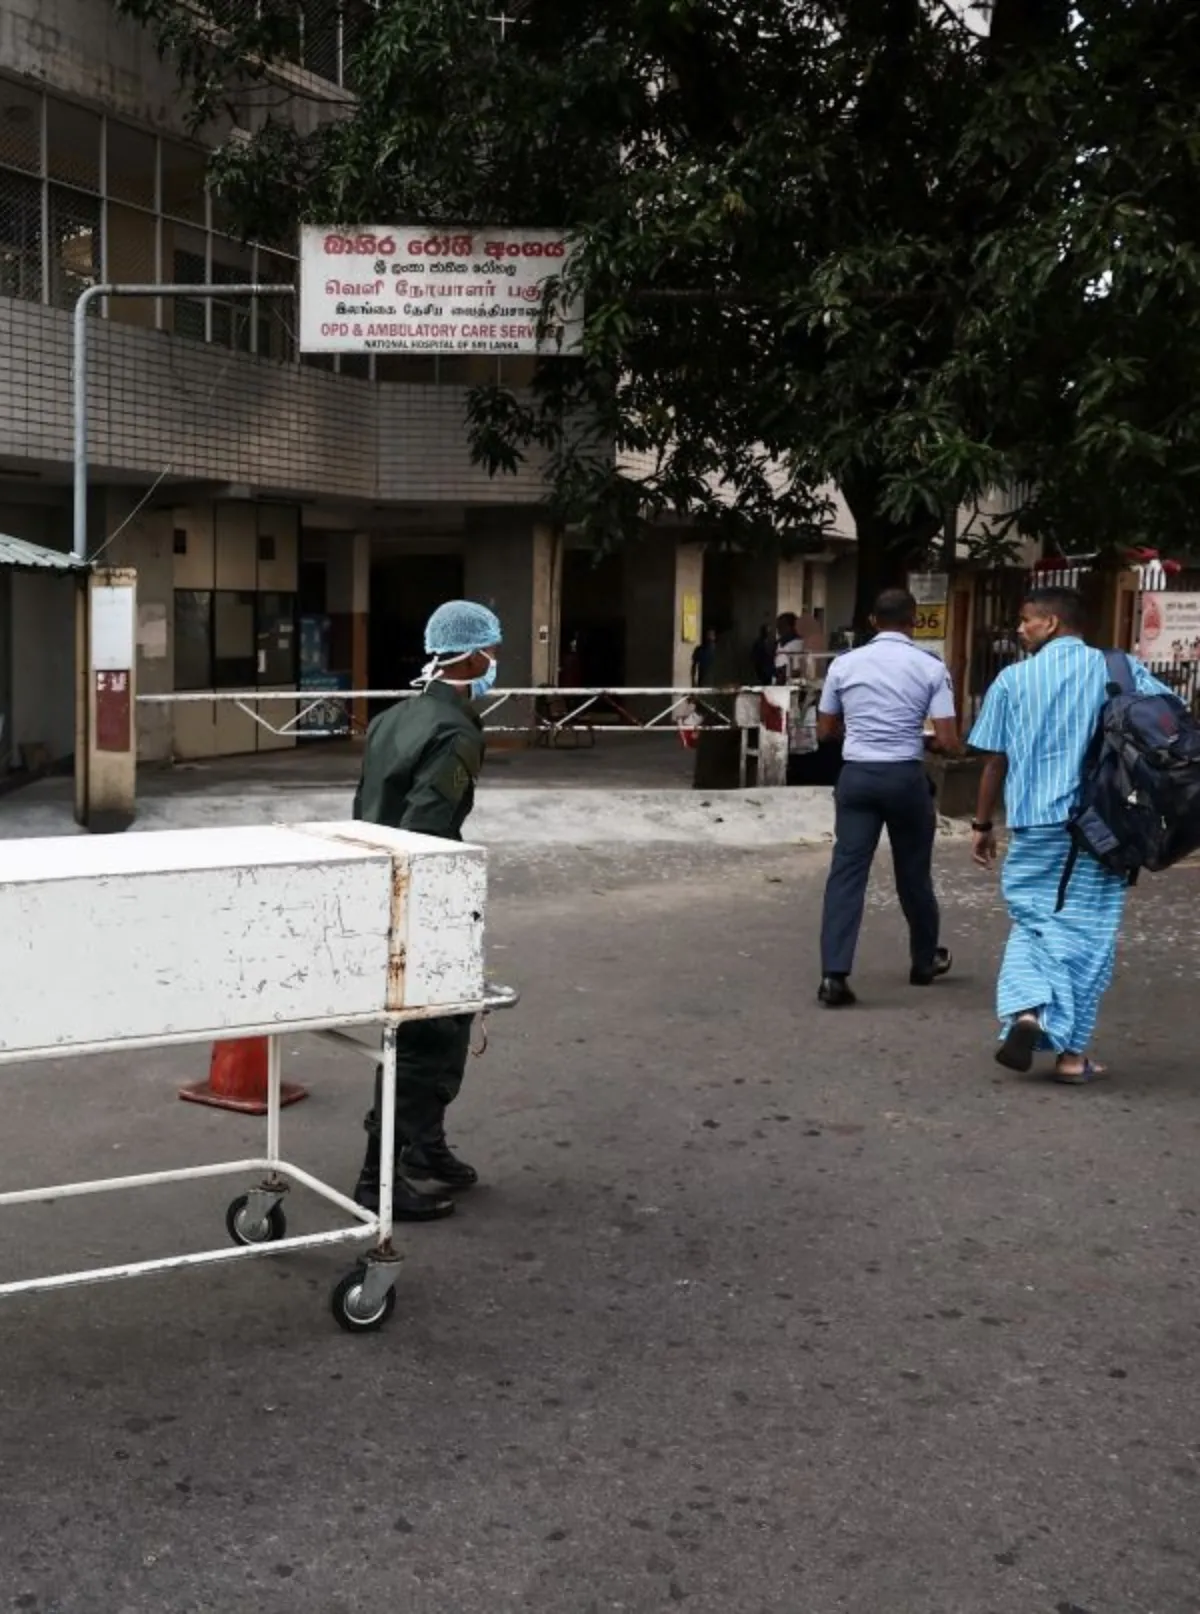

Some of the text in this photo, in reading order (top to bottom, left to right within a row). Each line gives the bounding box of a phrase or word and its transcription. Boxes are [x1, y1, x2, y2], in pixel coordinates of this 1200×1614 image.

[321, 323, 349, 337] OPD
[352, 323, 363, 337] &
[366, 323, 457, 338] AMBULATORY
[461, 324, 497, 338] CARE
[364, 339, 409, 349] NATIONAL
[411, 339, 454, 349] HOSPITAL
[472, 340, 487, 349] SRI
[490, 340, 519, 349] LANKA
